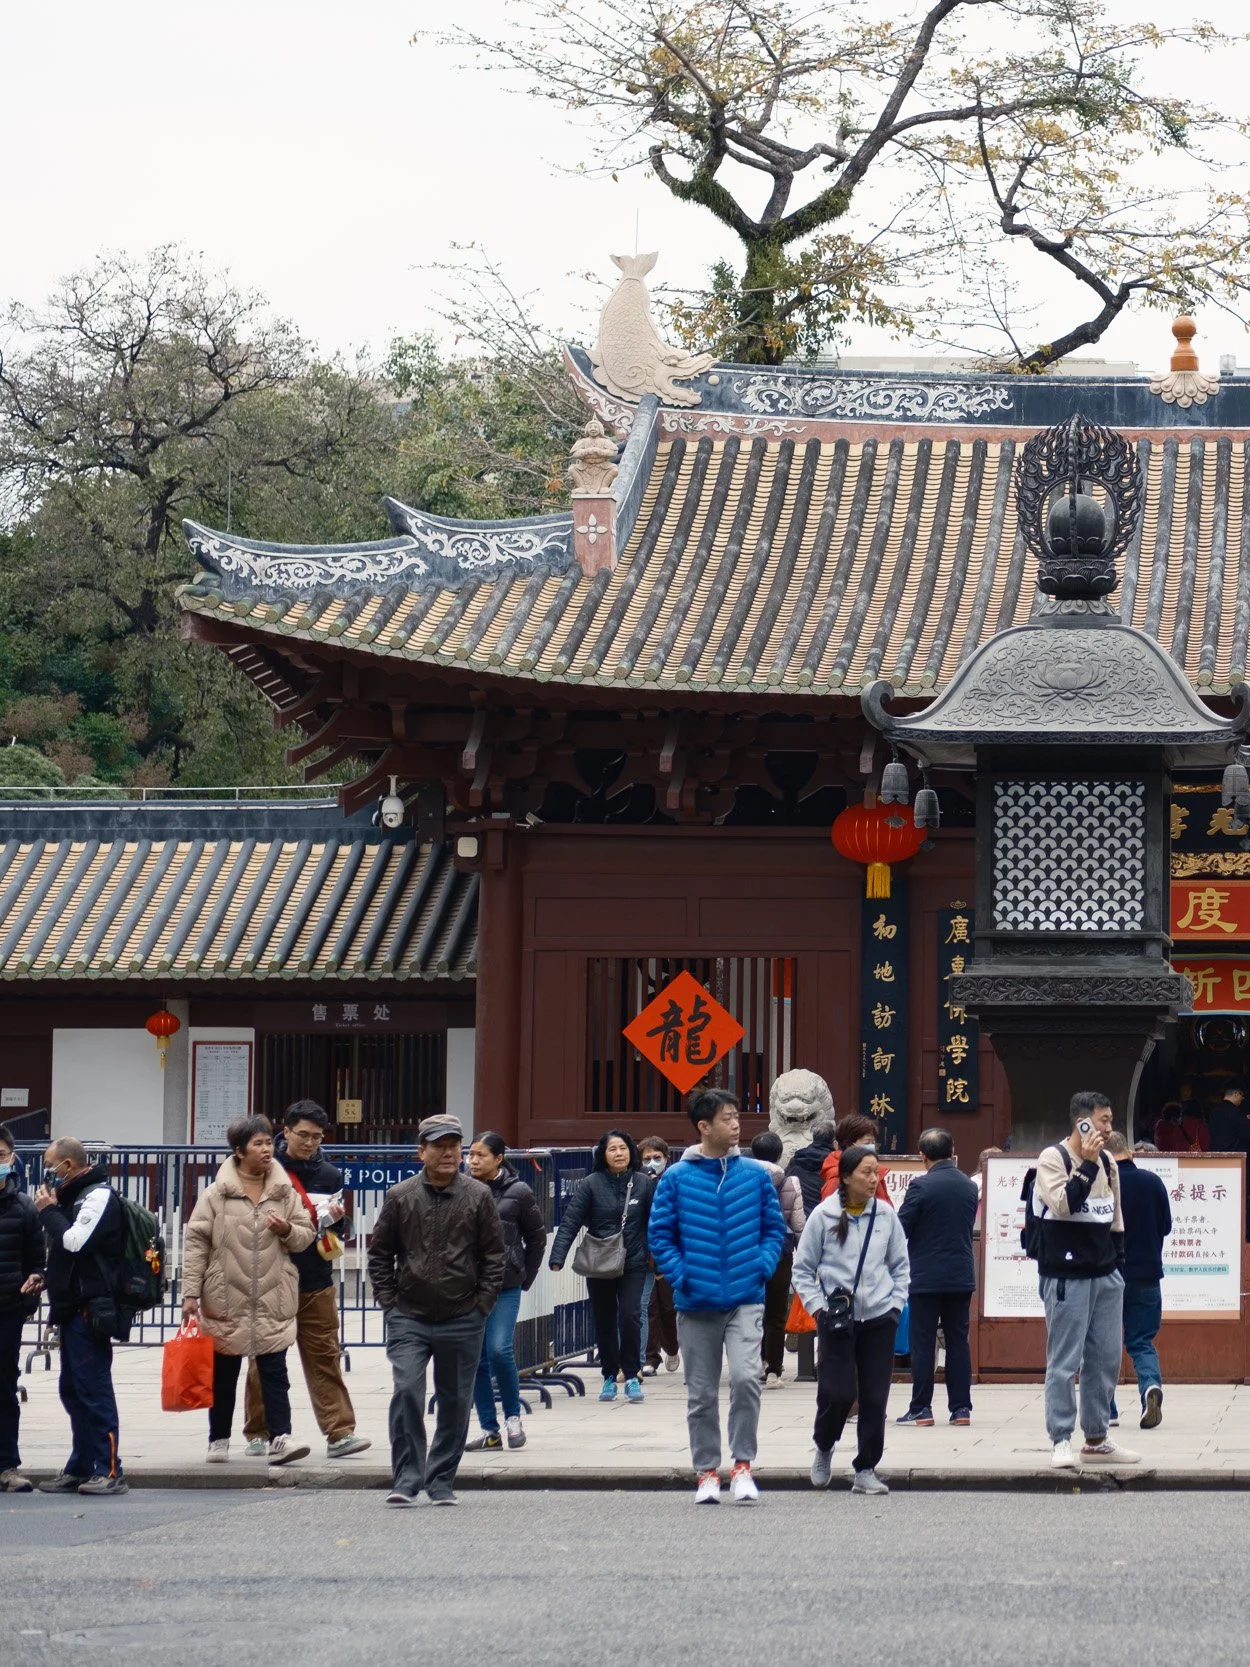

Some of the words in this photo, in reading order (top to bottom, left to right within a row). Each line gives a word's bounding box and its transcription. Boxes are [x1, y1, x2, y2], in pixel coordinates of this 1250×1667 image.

[312, 1003, 390, 1021] 售票处
[870, 914, 897, 1118] 初地訪訶林
[646, 994, 718, 1066] 龍
[359, 1169, 422, 1184] POLI
[1170, 1183, 1227, 1201] 馨提示
[1170, 1239, 1202, 1247] 未购票者
